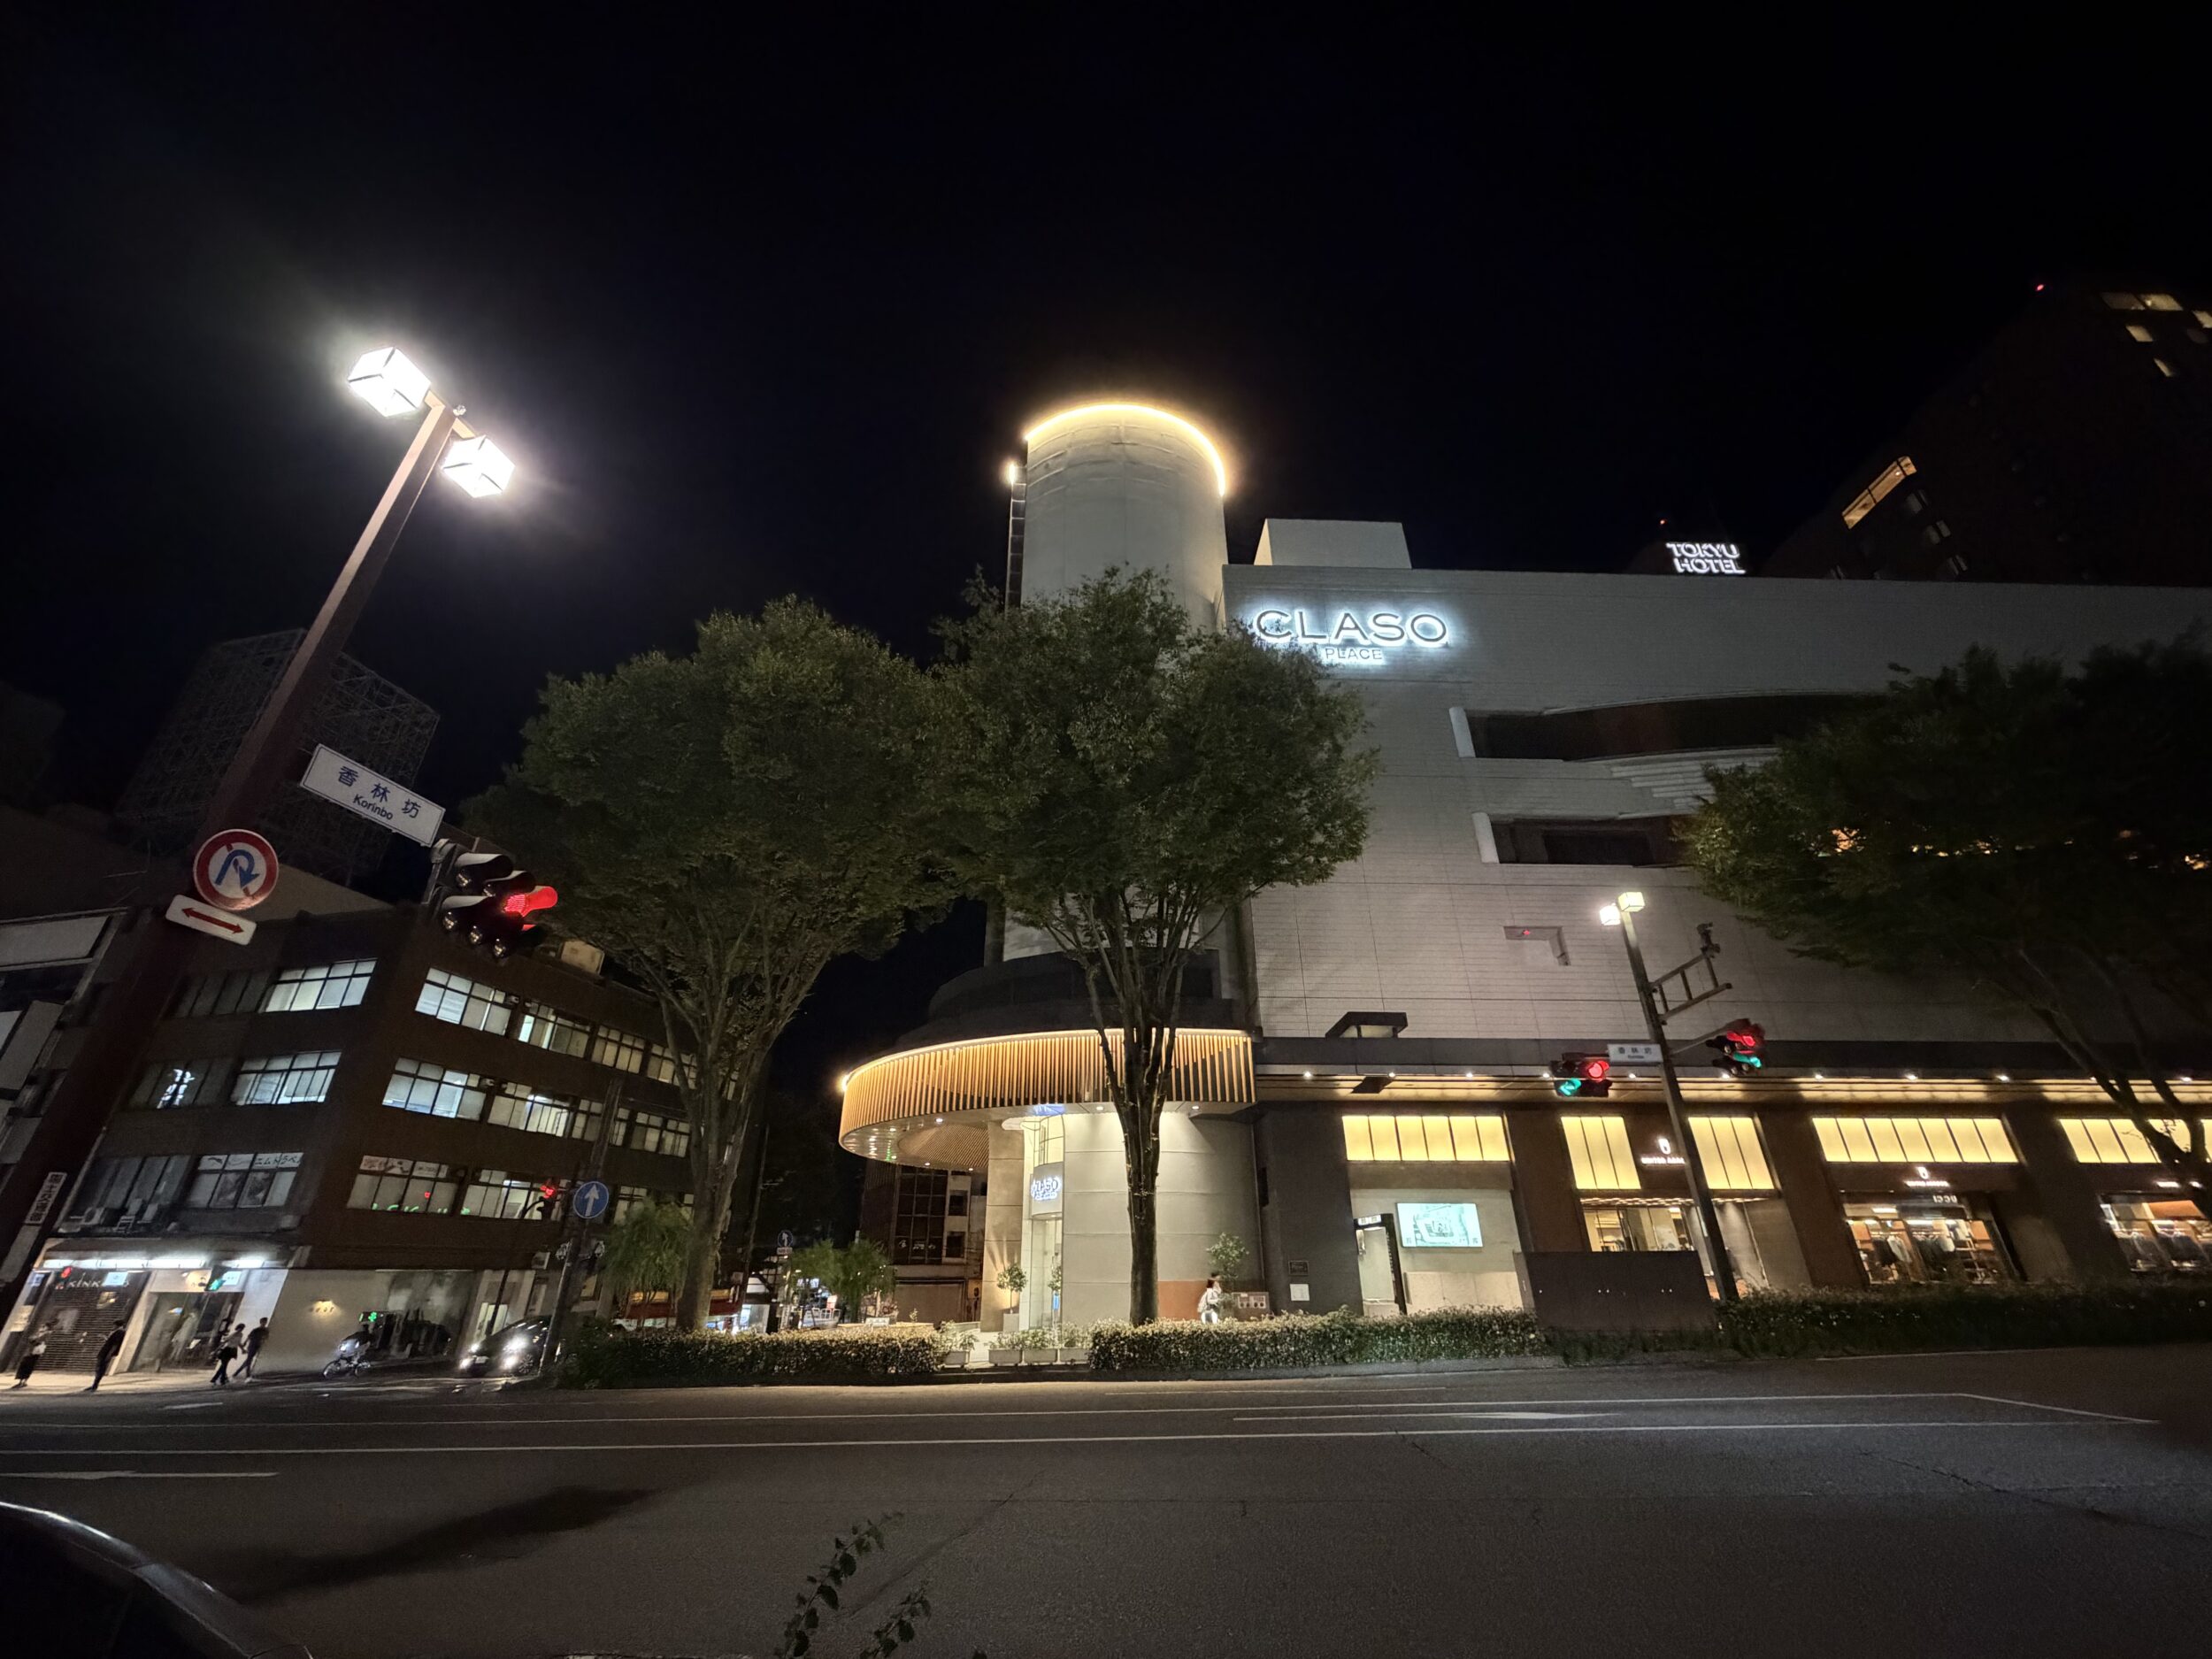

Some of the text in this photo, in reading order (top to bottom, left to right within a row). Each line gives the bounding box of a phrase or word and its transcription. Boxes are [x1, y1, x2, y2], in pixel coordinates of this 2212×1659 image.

[1665, 542, 1740, 558] TOKYU
[1673, 557, 1746, 574] HOTEL
[1256, 610, 1448, 643] CLASO
[1325, 648, 1383, 660] PLACE
[337, 765, 421, 819] 香林坊
[352, 794, 394, 820] Korinbo
